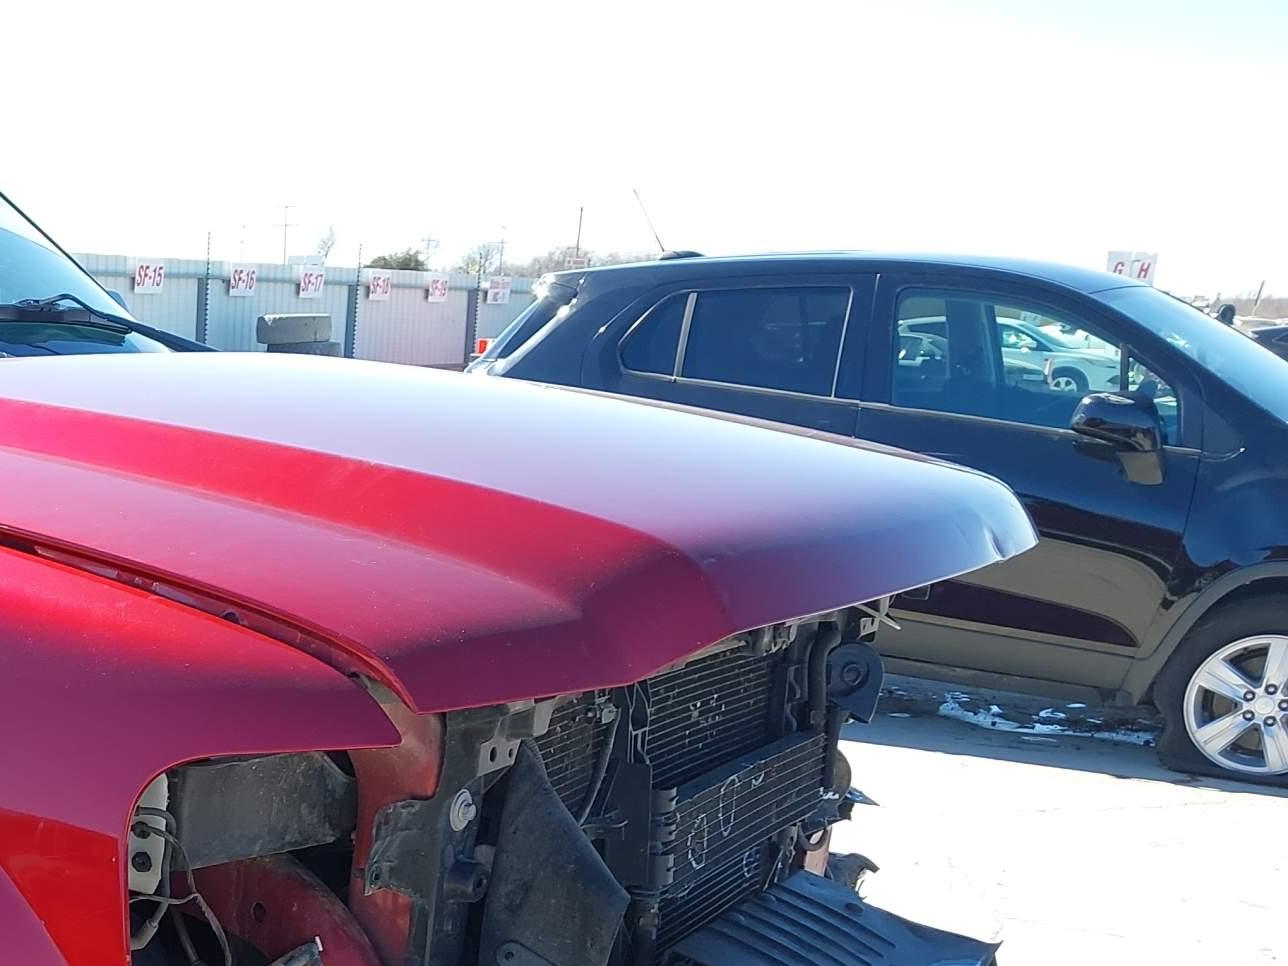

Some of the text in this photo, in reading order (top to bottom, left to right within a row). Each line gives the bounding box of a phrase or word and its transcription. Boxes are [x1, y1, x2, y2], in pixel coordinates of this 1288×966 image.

[136, 264, 164, 287] SF-15
[231, 269, 256, 290] SF-16
[1137, 262, 1150, 278] H
[301, 272, 324, 292] SF-17
[371, 276, 391, 295] SF-18
